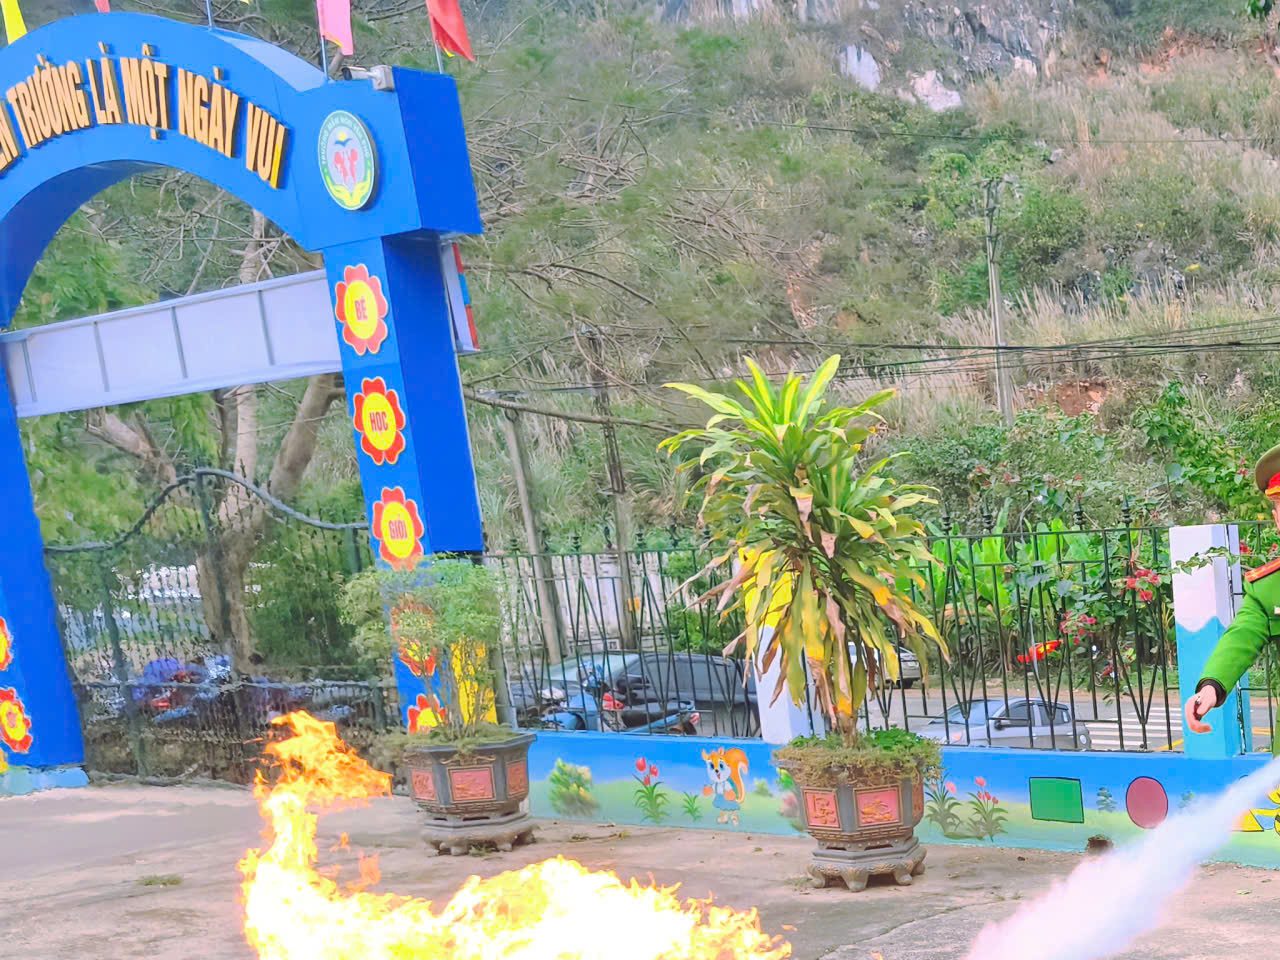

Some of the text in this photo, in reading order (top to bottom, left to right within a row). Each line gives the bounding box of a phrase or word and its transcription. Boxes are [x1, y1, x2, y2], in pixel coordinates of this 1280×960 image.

[6, 54, 91, 150] TRƯỜNG
[86, 42, 123, 124] LÀ
[120, 44, 171, 140] MỘT
[178, 66, 241, 159] NGÀY
[246, 101, 288, 190] VUI
[369, 410, 389, 437] HỌC
